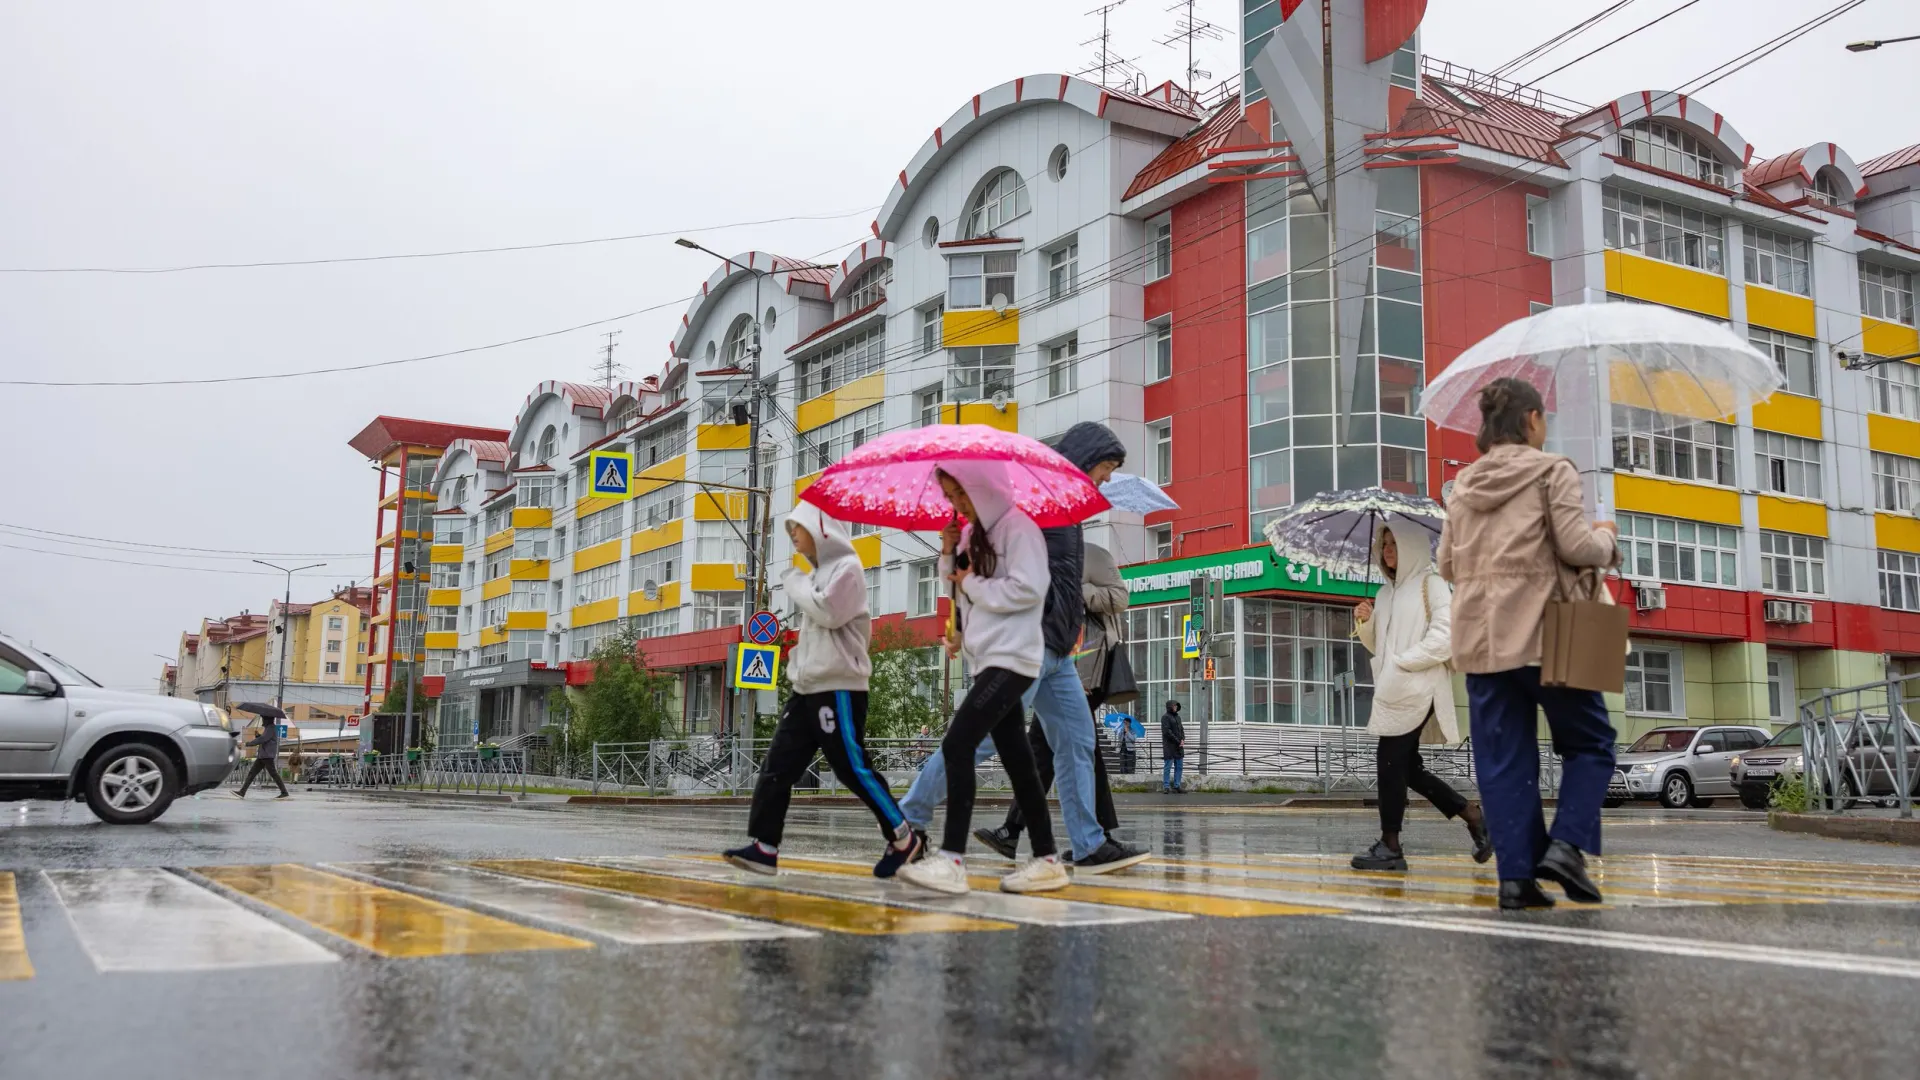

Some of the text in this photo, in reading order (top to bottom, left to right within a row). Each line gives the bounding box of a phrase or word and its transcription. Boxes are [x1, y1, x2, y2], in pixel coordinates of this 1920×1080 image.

[1133, 569, 1195, 593] ОБРАЩЕНИЮ
[1224, 564, 1233, 581] В
[1233, 560, 1264, 580] ЯНАО
[1192, 597, 1204, 612] 55
[818, 706, 836, 734] C
